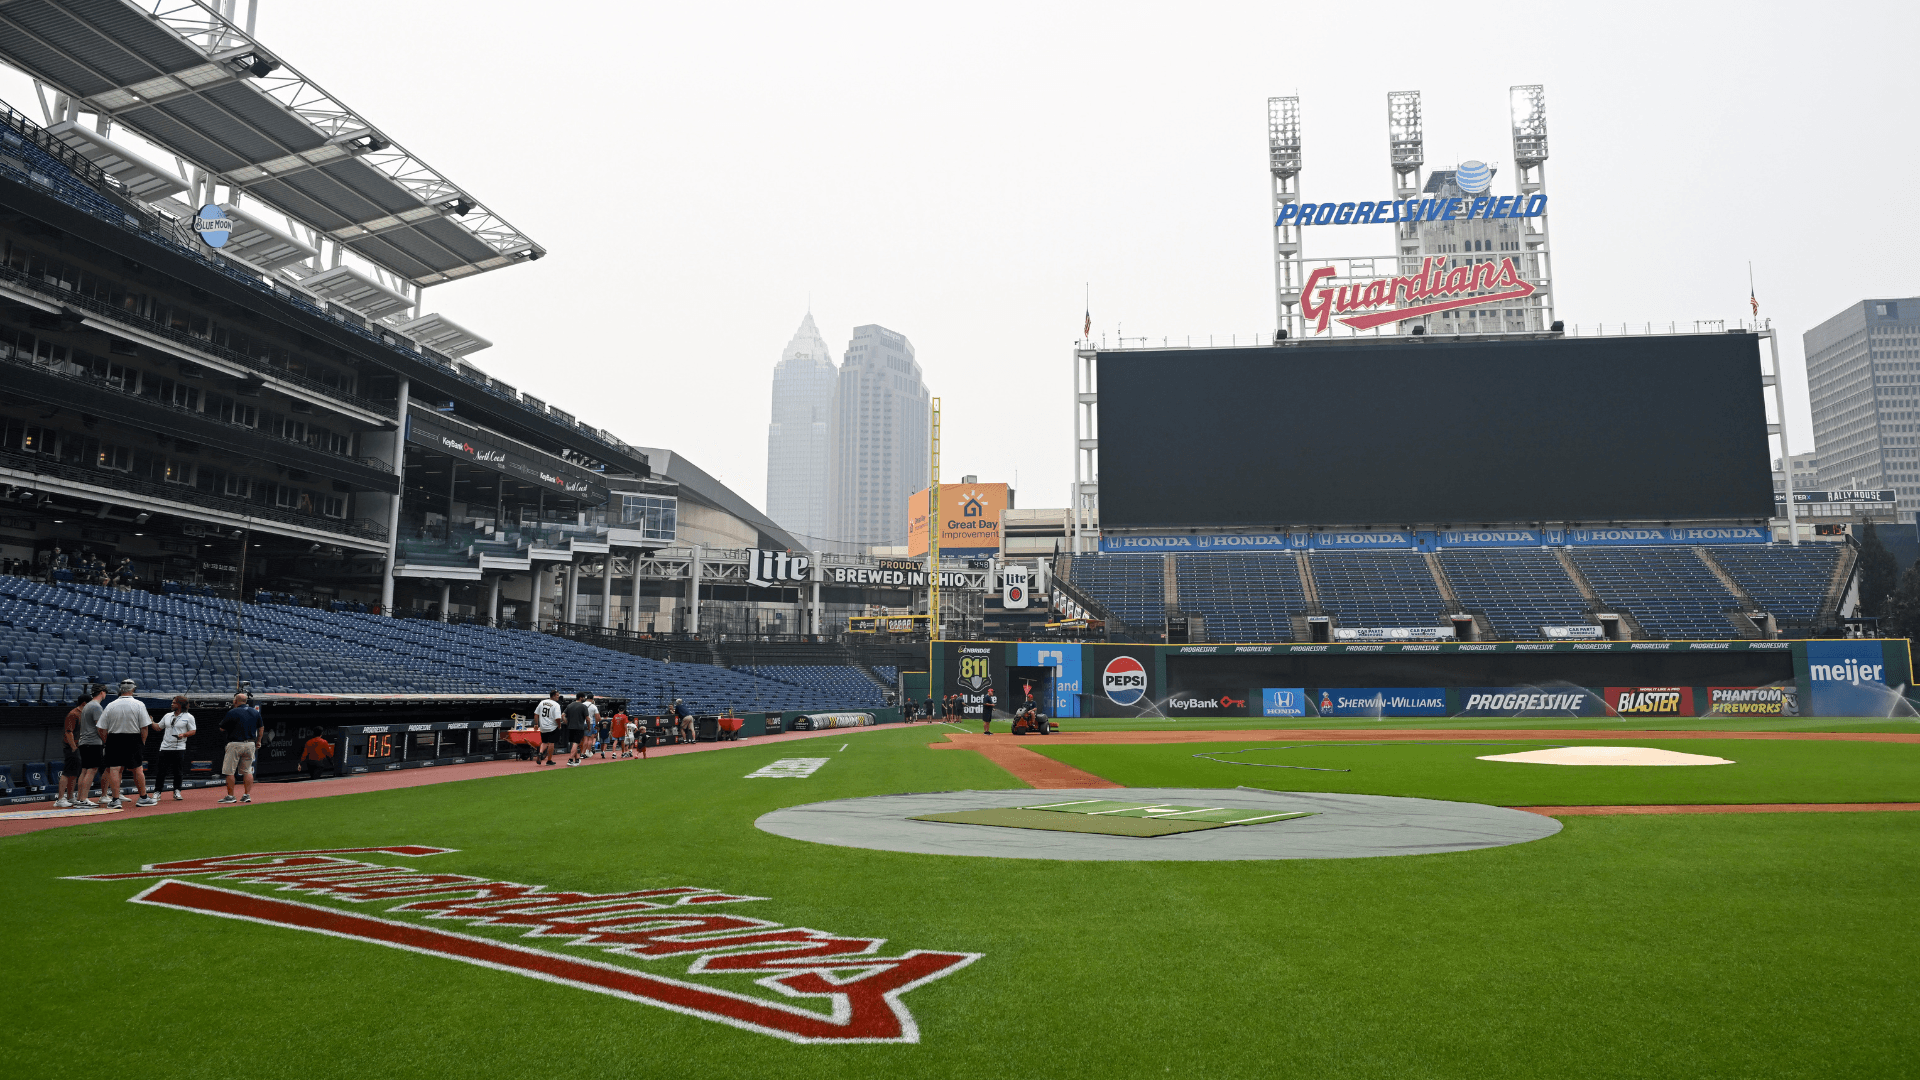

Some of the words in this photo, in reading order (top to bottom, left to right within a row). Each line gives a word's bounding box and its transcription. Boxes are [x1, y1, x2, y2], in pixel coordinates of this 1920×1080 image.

[1274, 198, 1462, 227] PROGRESSIVE
[1468, 194, 1548, 220] FIELD
[195, 217, 214, 230] BLUE
[215, 219, 232, 231] MOON
[1300, 255, 1536, 336] Guardians
[442, 436, 464, 451] KeyBank
[473, 450, 490, 462] North
[488, 451, 506, 462] Coast
[540, 472, 556, 483] KeyBank
[1828, 491, 1852, 502] RALLY
[1854, 491, 1882, 501] HOUSE
[947, 519, 977, 530] Great
[978, 519, 998, 530] Day
[942, 530, 1000, 540] Improvement
[1336, 534, 1407, 544] HONDA
[1464, 532, 1536, 542] HONDA
[1592, 530, 1666, 541] HONDA
[1688, 528, 1763, 539] HONDA
[1124, 537, 1192, 547] HONDA
[1213, 536, 1283, 546] HONDA
[745, 547, 809, 587] Lite
[880, 560, 923, 571] PROUDLY
[835, 568, 904, 584] BREWED
[907, 571, 924, 585] IN
[927, 572, 965, 587] OHIO
[1005, 573, 1026, 587] Lite
[961, 657, 988, 679] 811
[1810, 658, 1883, 686] meijer
[1105, 675, 1145, 687] PEPSI
[970, 694, 998, 703] befe
[1712, 690, 1782, 701] PHANTOM
[1169, 698, 1219, 710] KeyBank
[1466, 694, 1584, 710] PROGRESSIVE
[1617, 692, 1680, 712] BLASTER
[541, 707, 550, 718] 91
[1712, 703, 1782, 714] FIREWORKS
[362, 725, 391, 734] PROGRESSIVE
[448, 722, 469, 730] PROGRESSIVE
[367, 734, 392, 758] 0:15
[270, 749, 287, 758] Clinic
[54, 844, 986, 1044] Guardians
